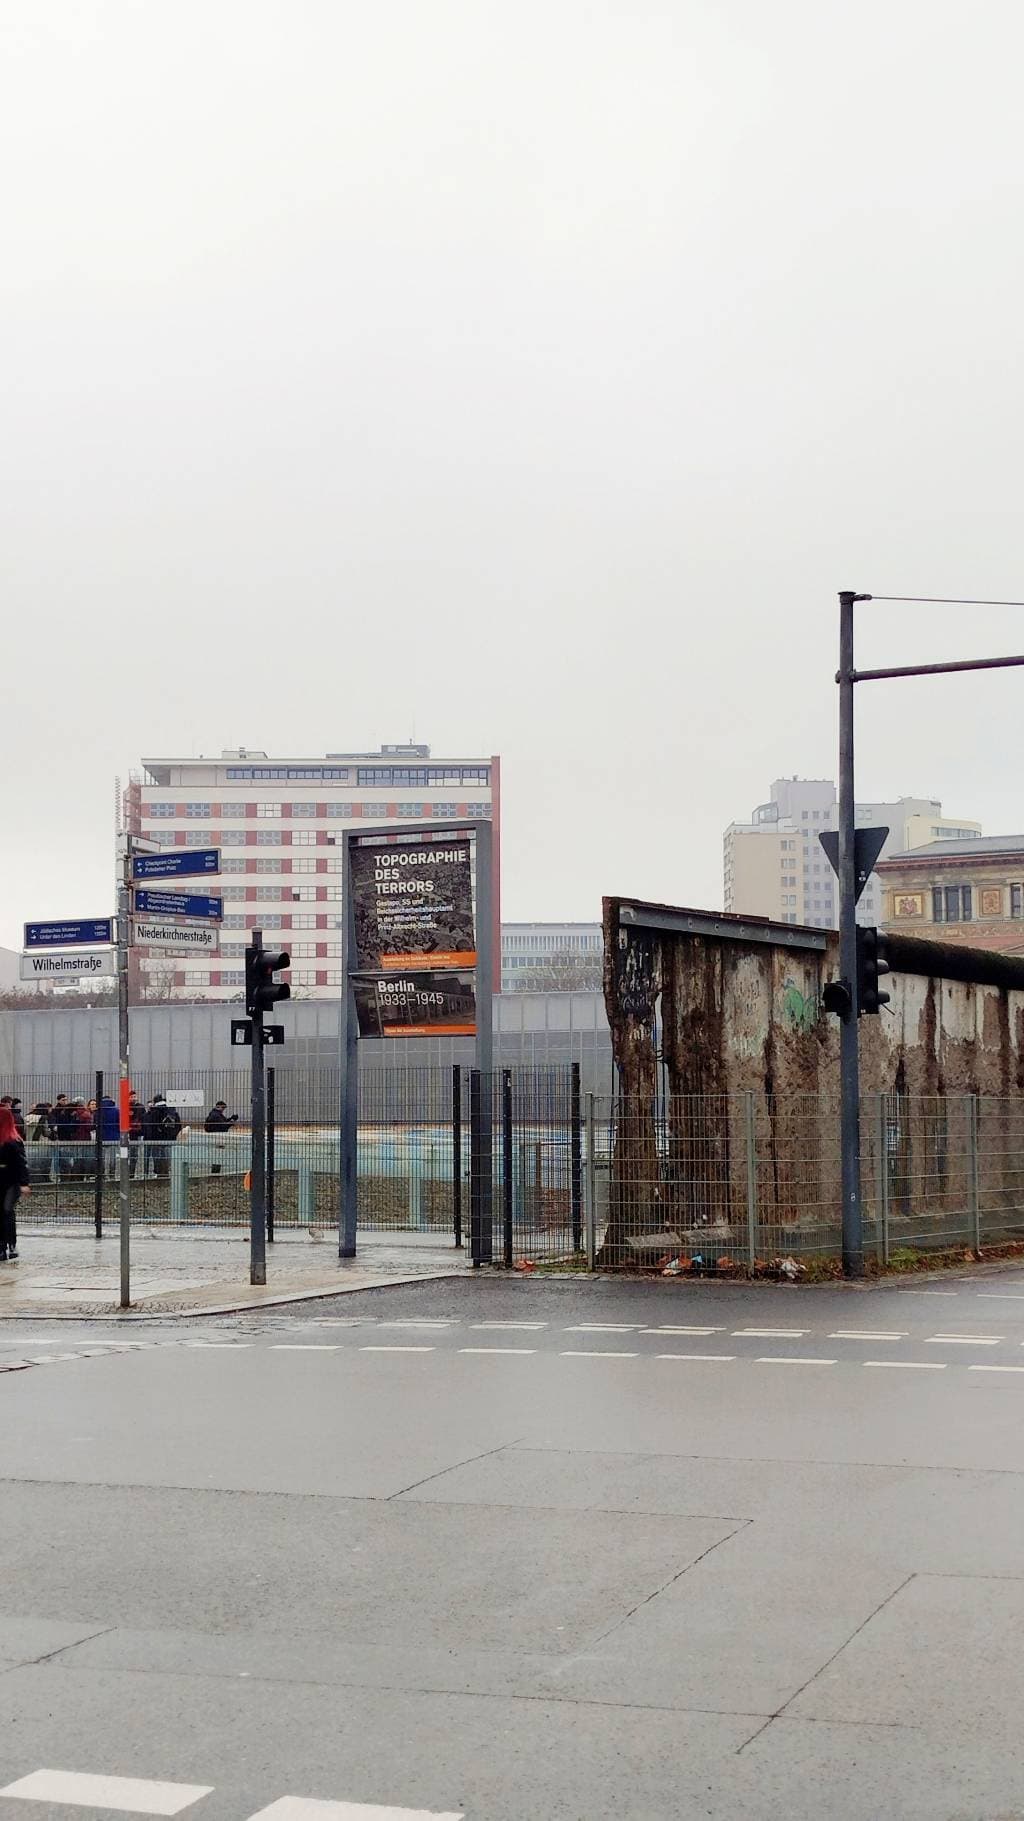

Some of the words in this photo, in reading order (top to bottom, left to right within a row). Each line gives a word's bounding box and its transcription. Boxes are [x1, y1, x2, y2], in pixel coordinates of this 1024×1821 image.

[374, 850, 466, 866] TOPOGRAPHIE
[375, 868, 400, 880] DES
[375, 880, 434, 894] TERRORS
[137, 925, 212, 945] Niederkirchnerstraße
[33, 956, 102, 971] Wilhelmstraße
[378, 980, 415, 992] Berlin
